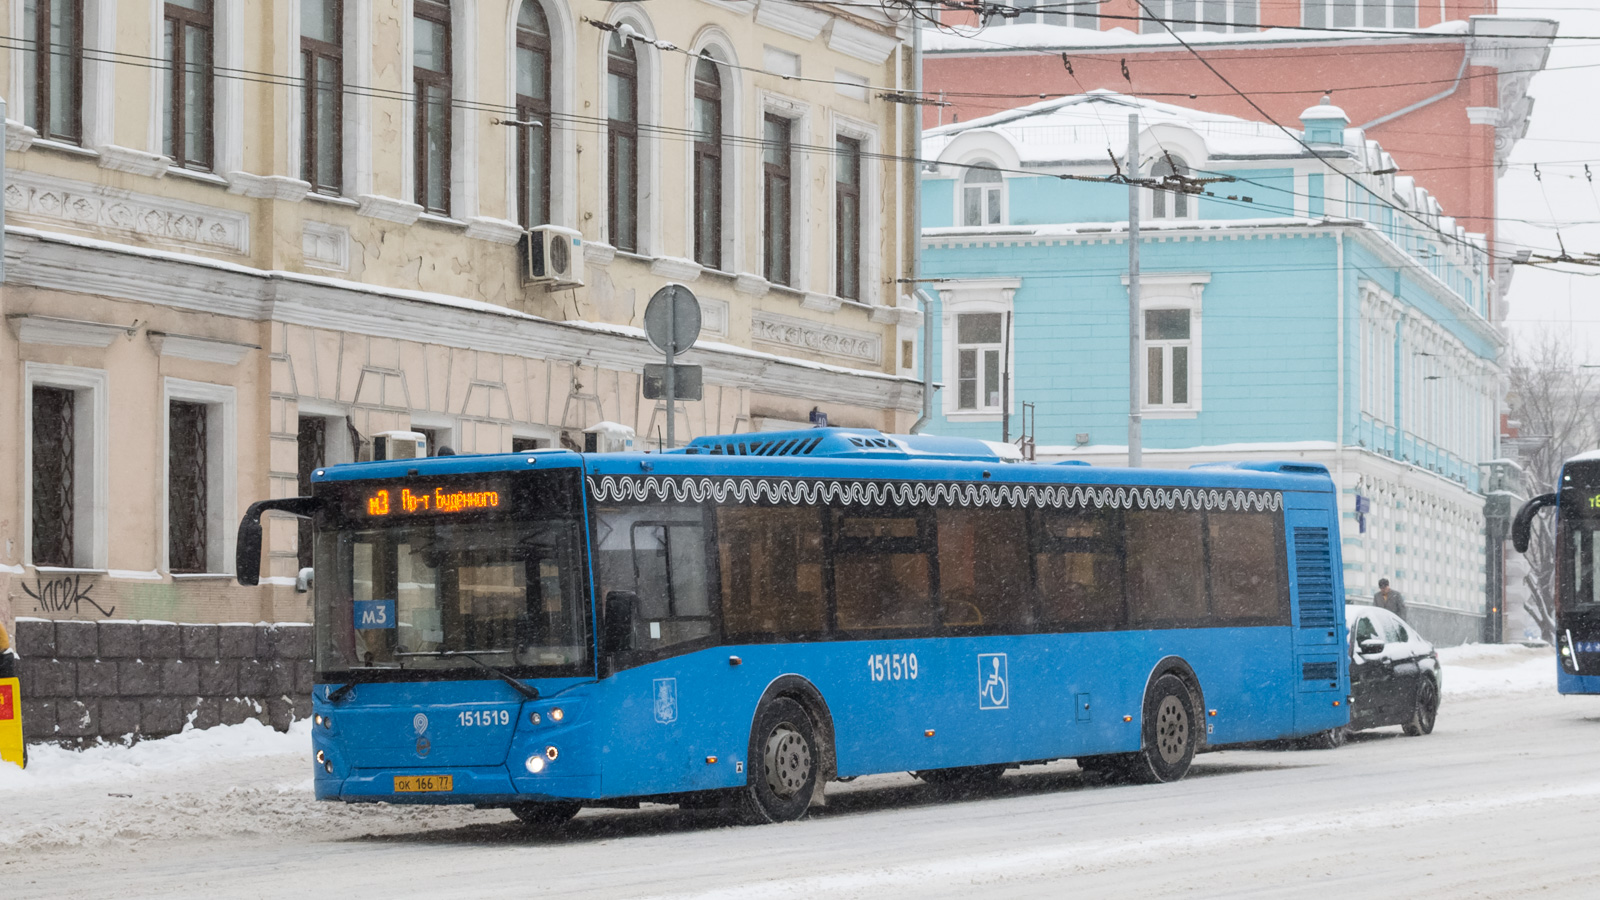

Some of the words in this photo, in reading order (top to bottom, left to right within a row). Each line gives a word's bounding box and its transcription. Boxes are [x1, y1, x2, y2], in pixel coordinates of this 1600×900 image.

[368, 490, 389, 515] м3
[402, 488, 430, 512] Пр-т
[435, 487, 499, 513] Будённого
[361, 605, 387, 624] м3
[867, 652, 919, 682] 151519
[458, 709, 510, 727] 151519
[415, 777, 434, 790] 166
[439, 776, 449, 786] 77
